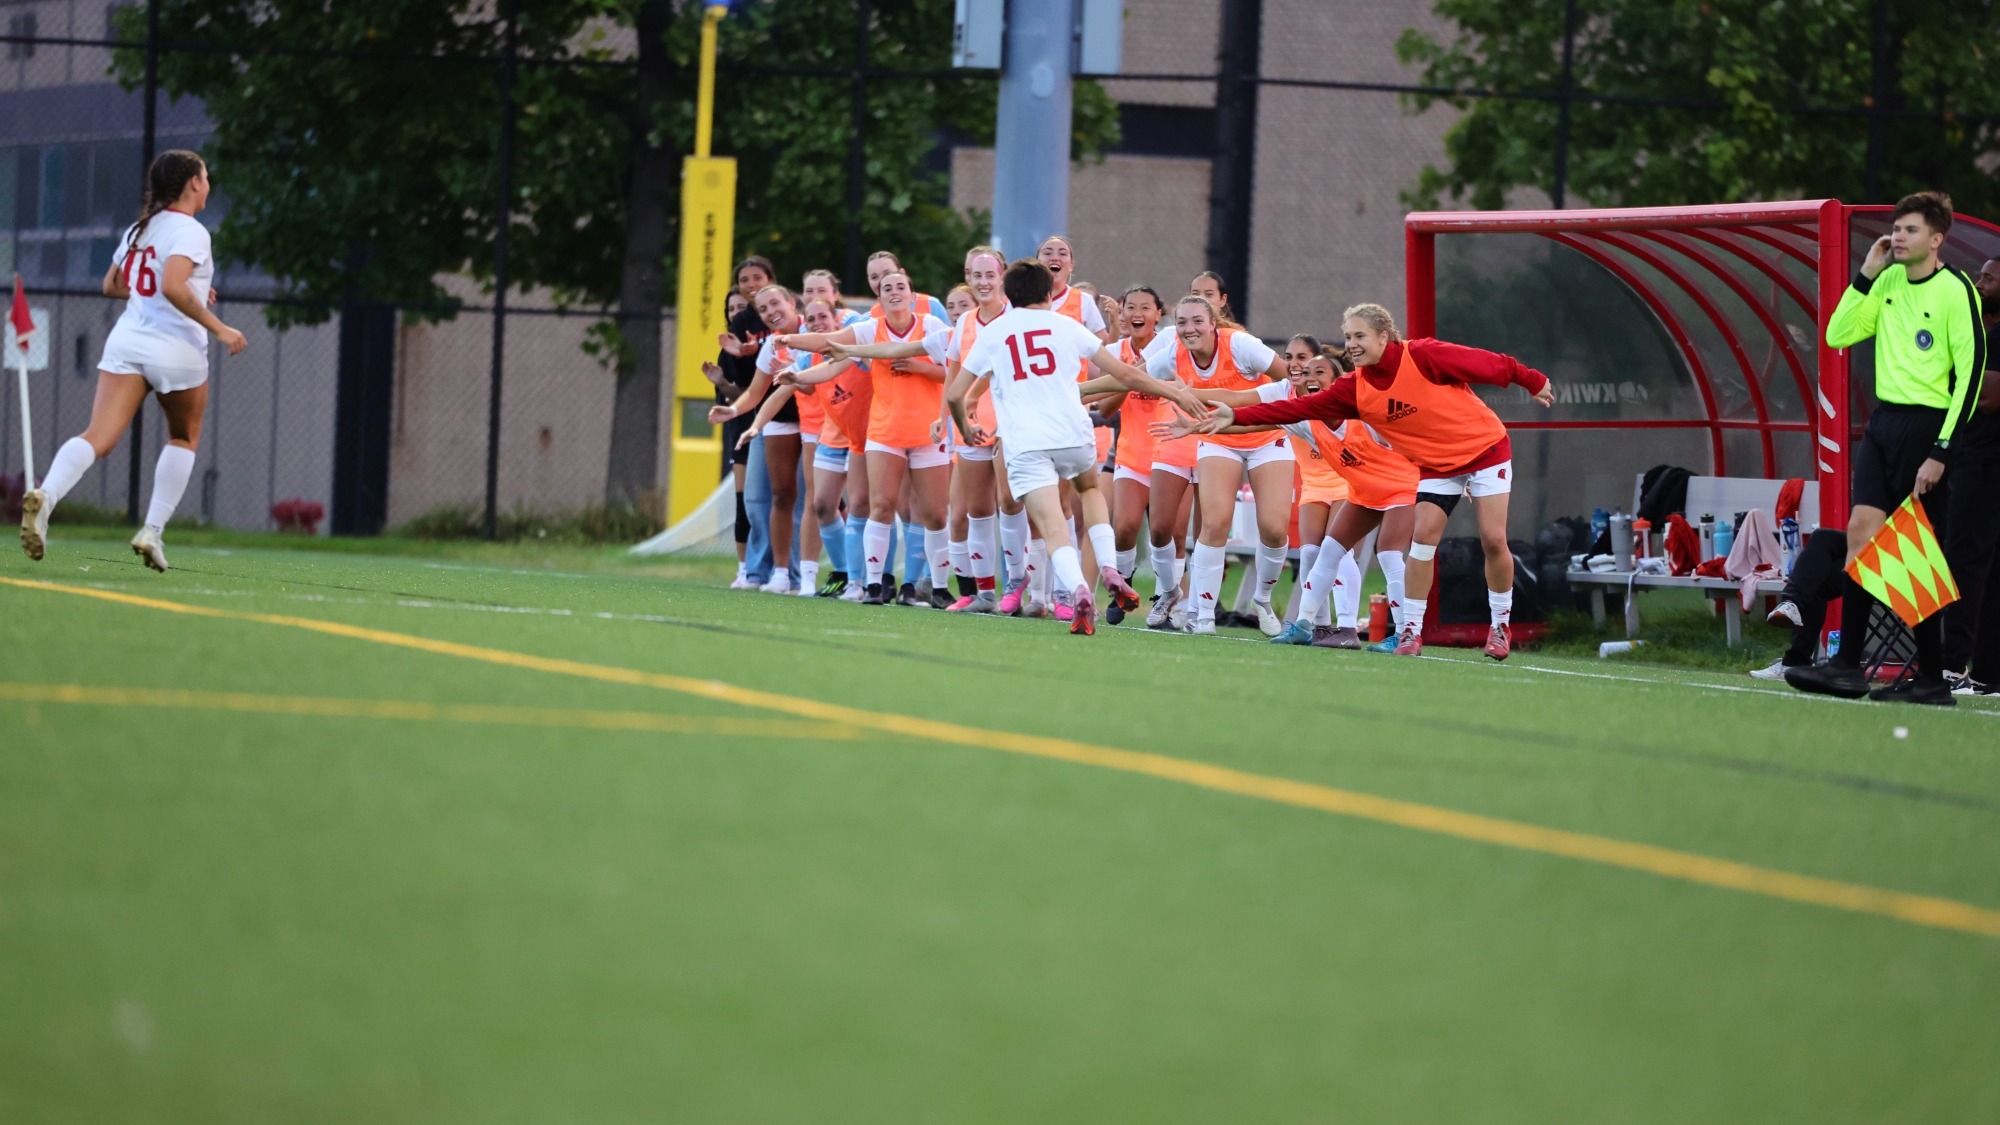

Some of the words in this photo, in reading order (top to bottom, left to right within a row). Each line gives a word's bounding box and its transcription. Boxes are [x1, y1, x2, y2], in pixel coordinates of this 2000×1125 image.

[122, 245, 157, 298] 16
[702, 212, 716, 332] EMERGENCY
[1004, 329, 1057, 382] 15
